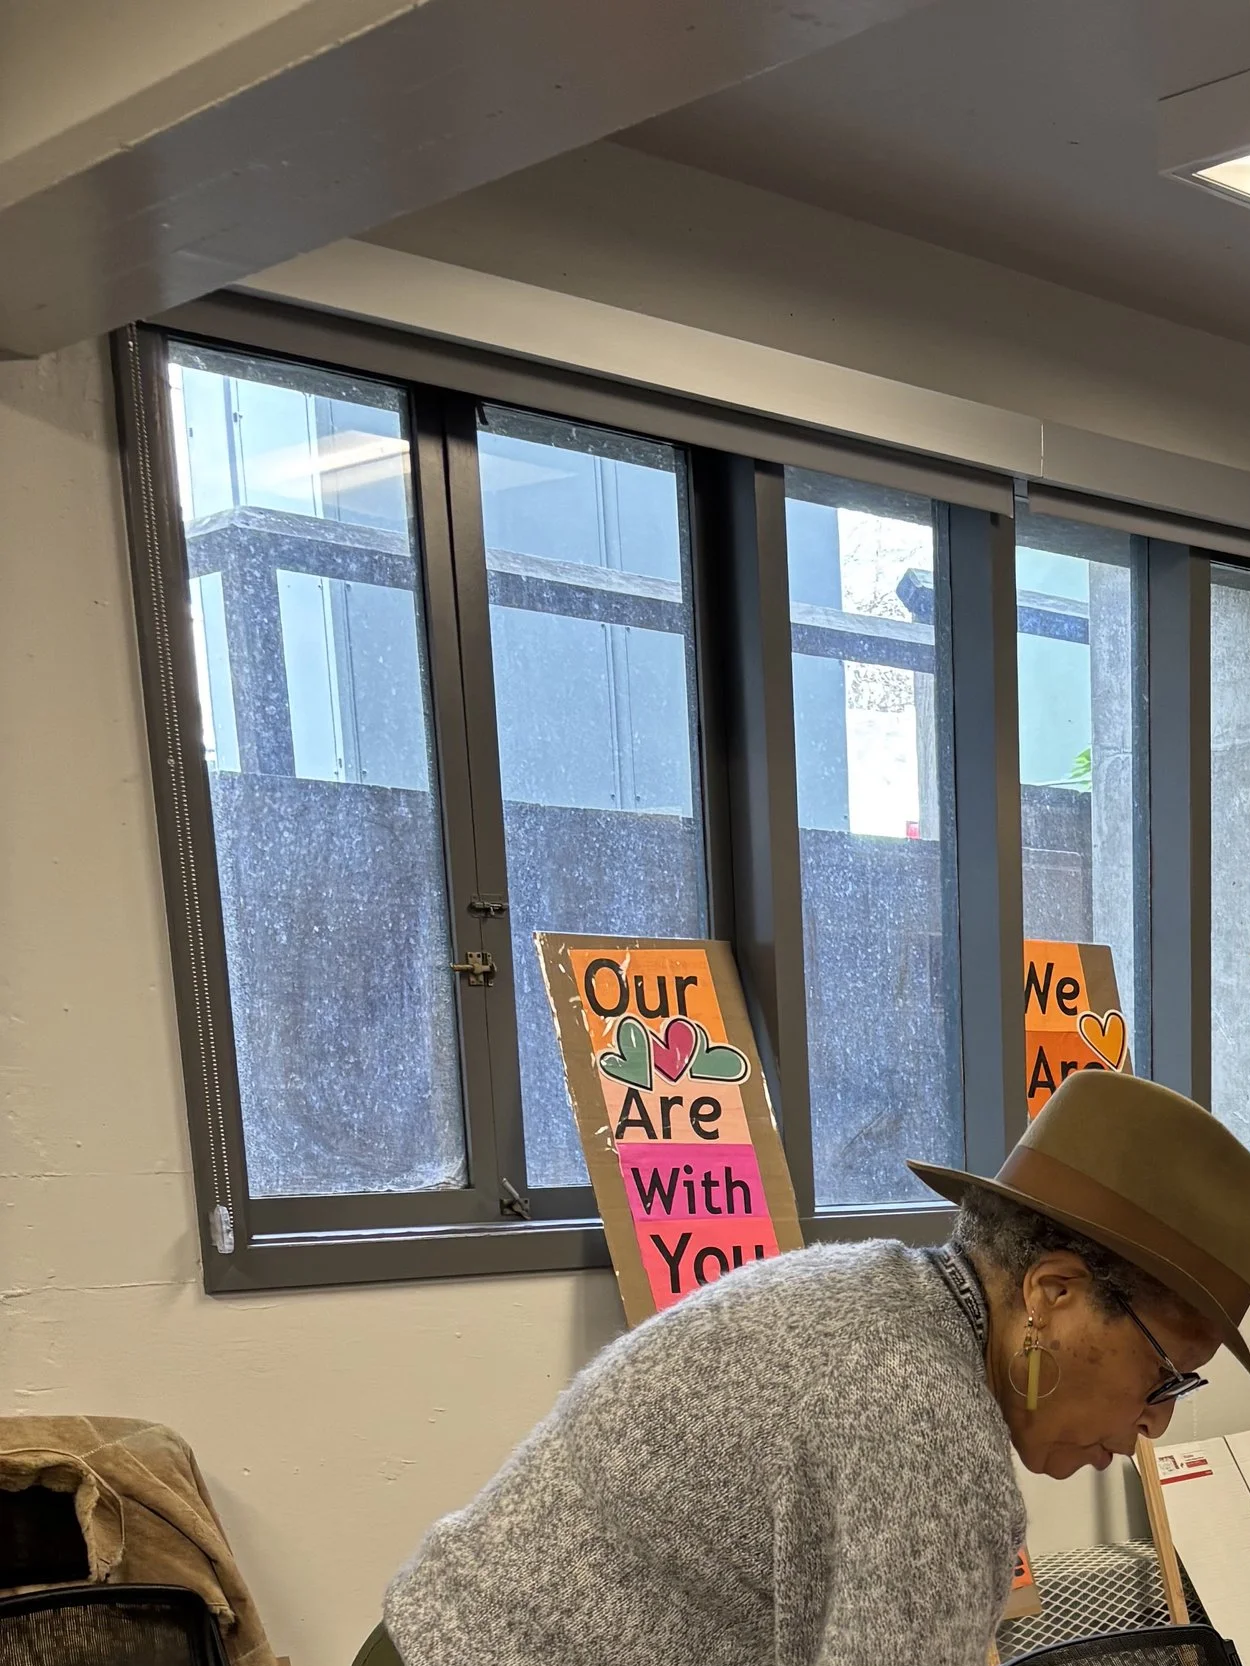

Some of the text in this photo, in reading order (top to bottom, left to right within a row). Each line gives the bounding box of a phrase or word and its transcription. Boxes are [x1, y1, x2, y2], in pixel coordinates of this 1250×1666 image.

[583, 957, 698, 1019] Our
[614, 1088, 722, 1141] Are
[631, 1164, 752, 1216] With
